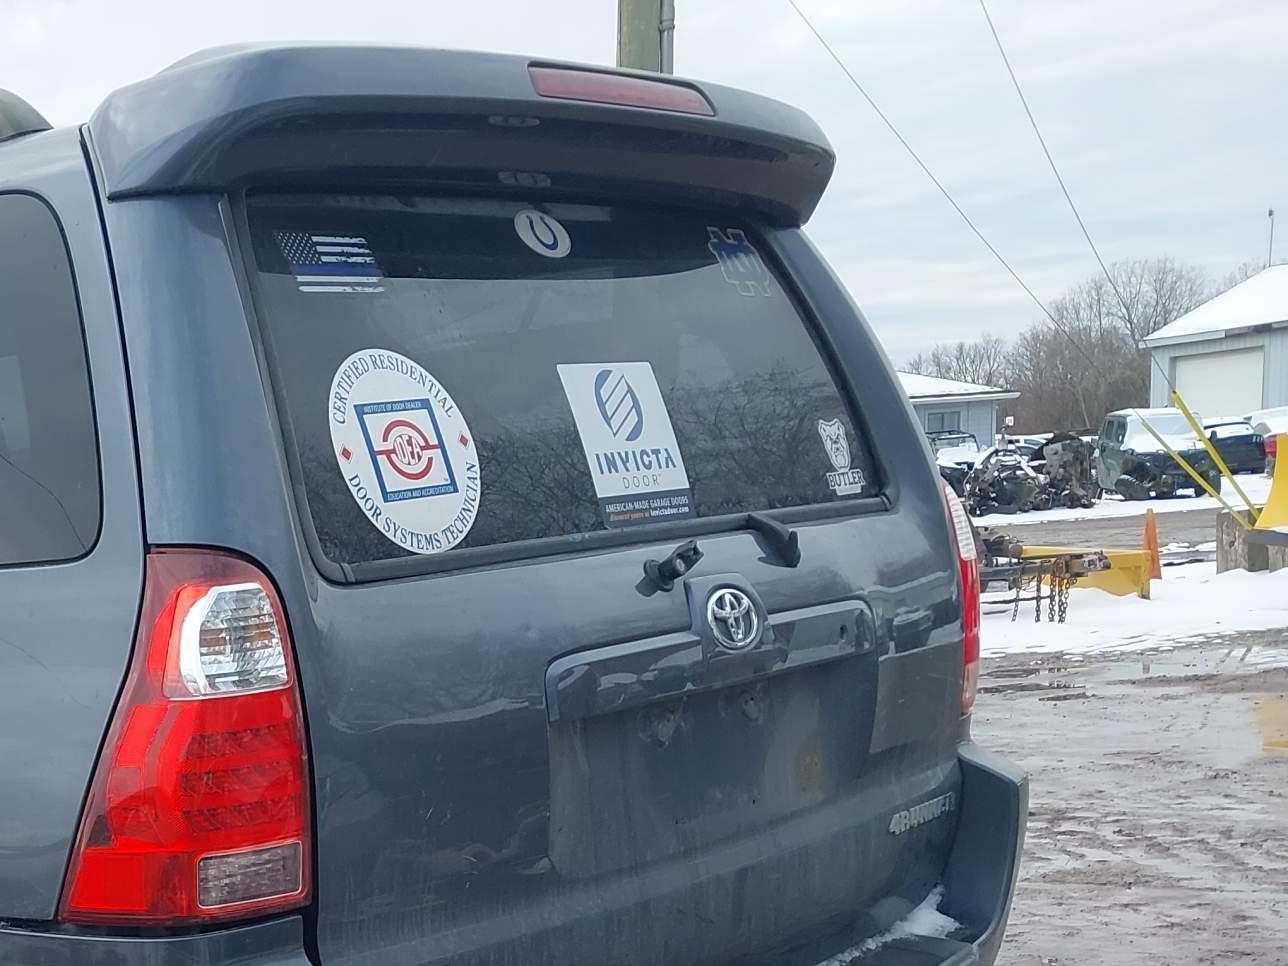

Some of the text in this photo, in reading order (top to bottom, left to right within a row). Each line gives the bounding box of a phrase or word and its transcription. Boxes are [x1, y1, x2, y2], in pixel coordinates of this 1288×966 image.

[332, 354, 453, 425] CERTIFIED RESIDENTIAL
[394, 434, 424, 465] IDEA
[595, 448, 677, 475] INVICTA
[623, 475, 660, 488] DOOR
[827, 470, 865, 488] BUTLER
[348, 461, 479, 550] DOOR SYSTEMS TECHNICIAN
